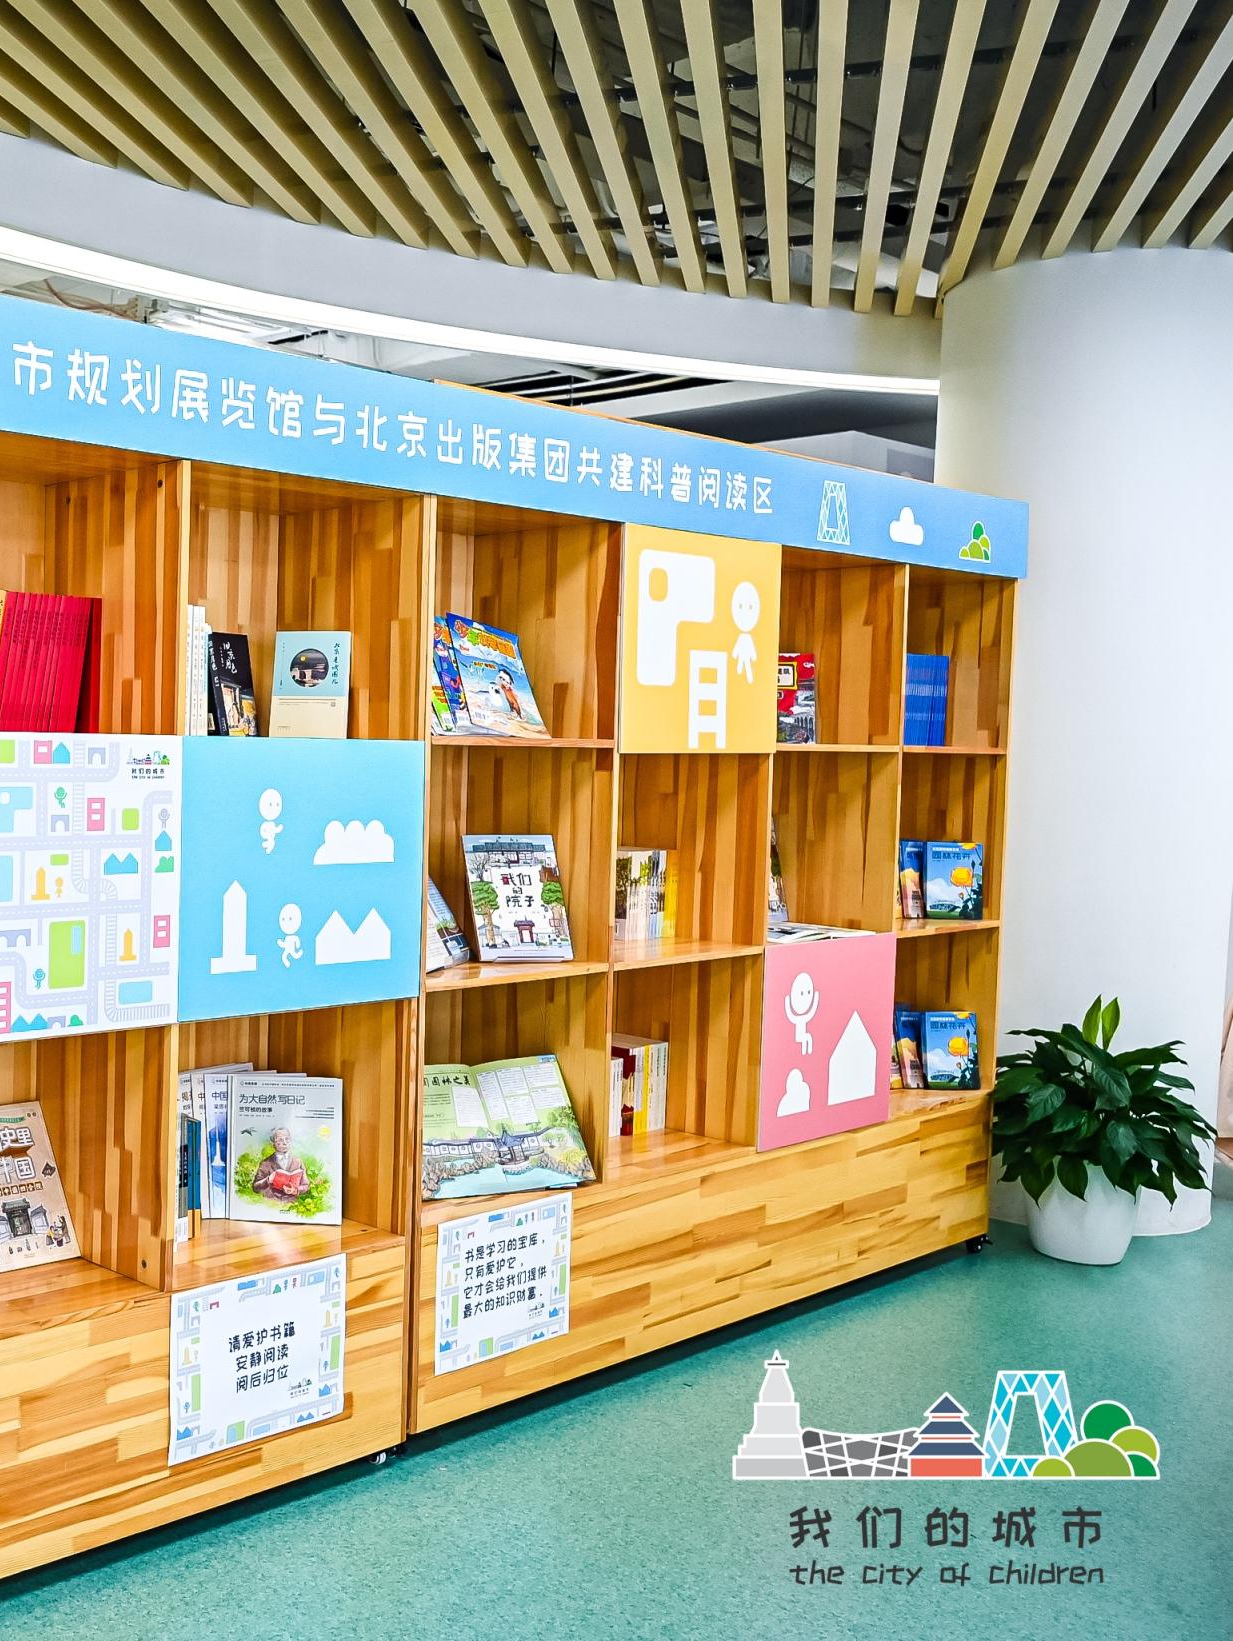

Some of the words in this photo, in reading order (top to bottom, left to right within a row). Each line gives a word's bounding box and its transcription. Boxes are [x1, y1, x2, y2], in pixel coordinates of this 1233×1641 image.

[500, 872, 532, 887] 我们
[512, 886, 523, 895] 的
[506, 895, 535, 908] 院子
[238, 1093, 305, 1106] 为大自然写日记
[464, 1232, 546, 1264] 书是学习的宝库，
[463, 1265, 548, 1300] 它才会给我们提供
[464, 1256, 525, 1282] 只有爱护它，
[228, 1320, 297, 1354] 请爱护书籍
[235, 1343, 290, 1373] 安静阅读
[235, 1364, 290, 1394] 阅后归位
